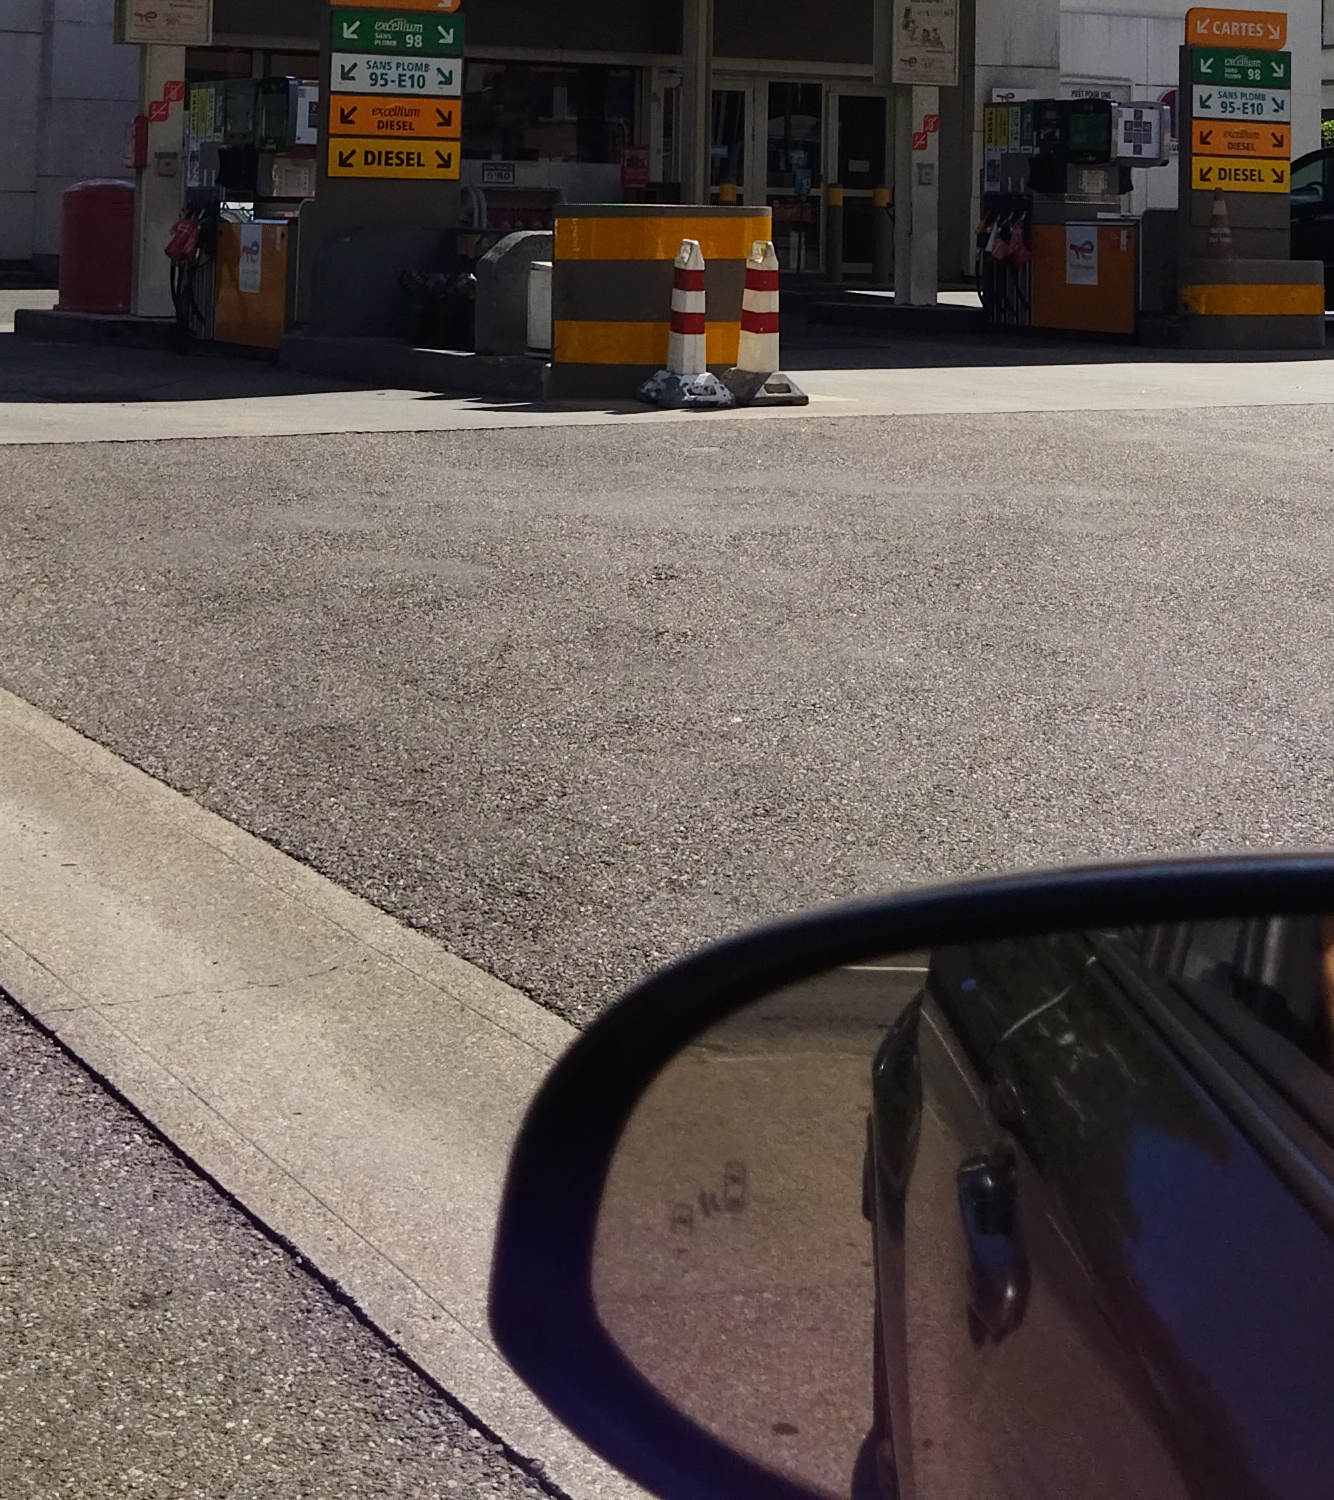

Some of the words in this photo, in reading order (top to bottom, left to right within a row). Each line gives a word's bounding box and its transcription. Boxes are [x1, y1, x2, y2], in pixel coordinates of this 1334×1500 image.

[374, 18, 424, 33] excellium
[1212, 21, 1264, 37] CARTES
[405, 34, 423, 48] 98
[366, 60, 392, 71] SANS
[395, 61, 430, 73] PLOMB
[369, 72, 426, 89] 95-E10
[1247, 69, 1261, 81] 98
[1218, 91, 1238, 99] SANS
[1240, 92, 1266, 101] PLOMB
[372, 104, 421, 117] excellium
[1220, 102, 1264, 116] 95-E10
[377, 120, 415, 131] DIESEL
[1227, 142, 1256, 151] DIESEL
[363, 150, 426, 168] DIESEL
[1218, 168, 1265, 183] DIESEL
